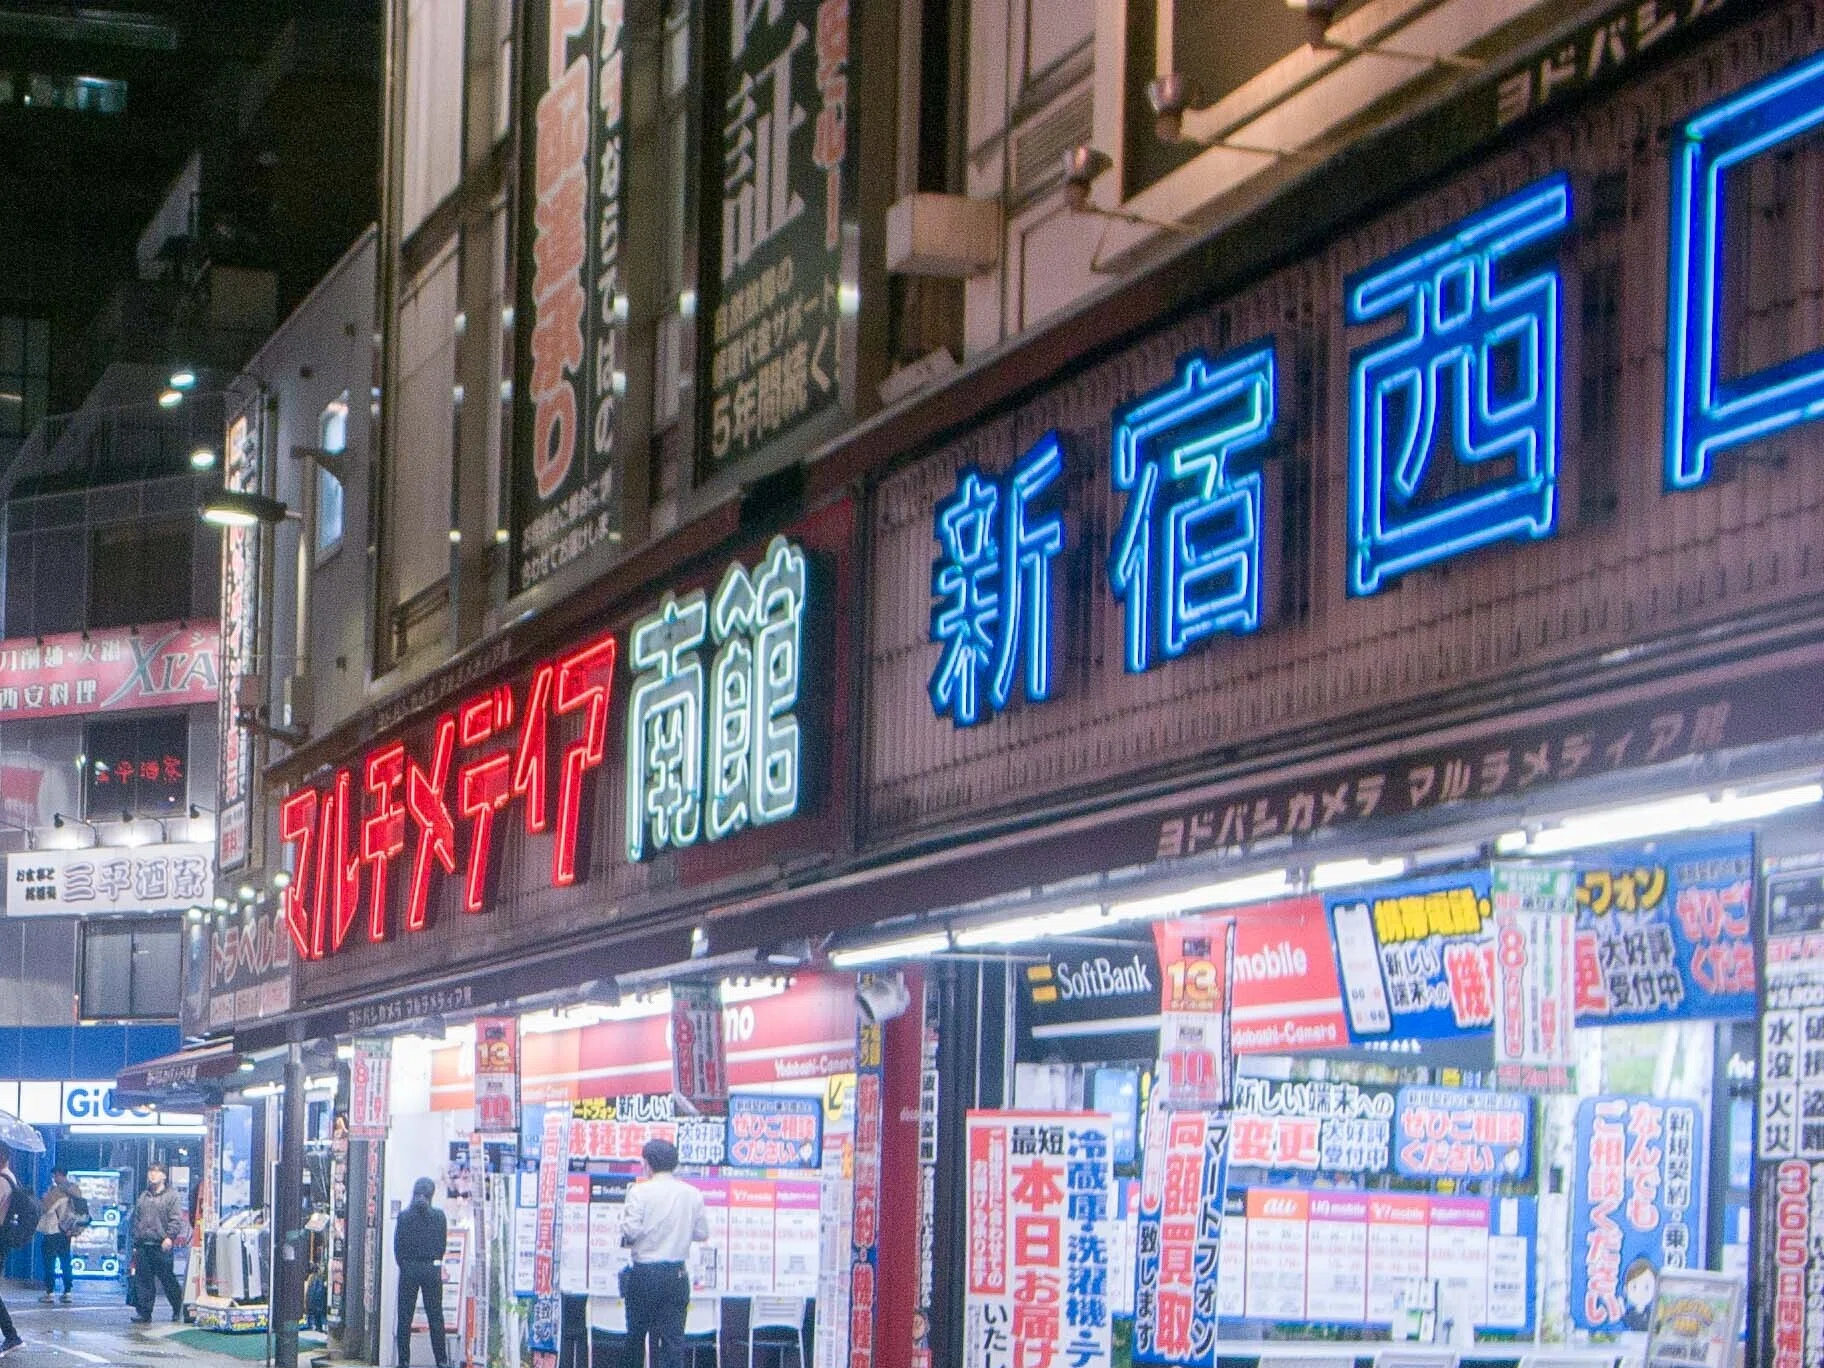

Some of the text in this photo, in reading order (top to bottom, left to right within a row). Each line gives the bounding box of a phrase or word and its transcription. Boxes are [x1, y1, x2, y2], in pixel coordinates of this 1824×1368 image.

[281, 633, 617, 962] マルチメディア
[626, 534, 806, 862] 南館
[1158, 772, 1383, 860] ヨドバシカメラ
[1057, 955, 1153, 1002] SoftBank
[1600, 924, 1673, 967] 大好評
[1609, 966, 1683, 1009] 受付中
[66, 1088, 150, 1119] Gi
[1011, 1125, 1064, 1157] 最短
[1627, 1103, 1662, 1231] なんでも
[1193, 1108, 1233, 1354] マートフォン
[1587, 1101, 1627, 1325] ご相談ください
[1137, 1223, 1160, 1353] 致します
